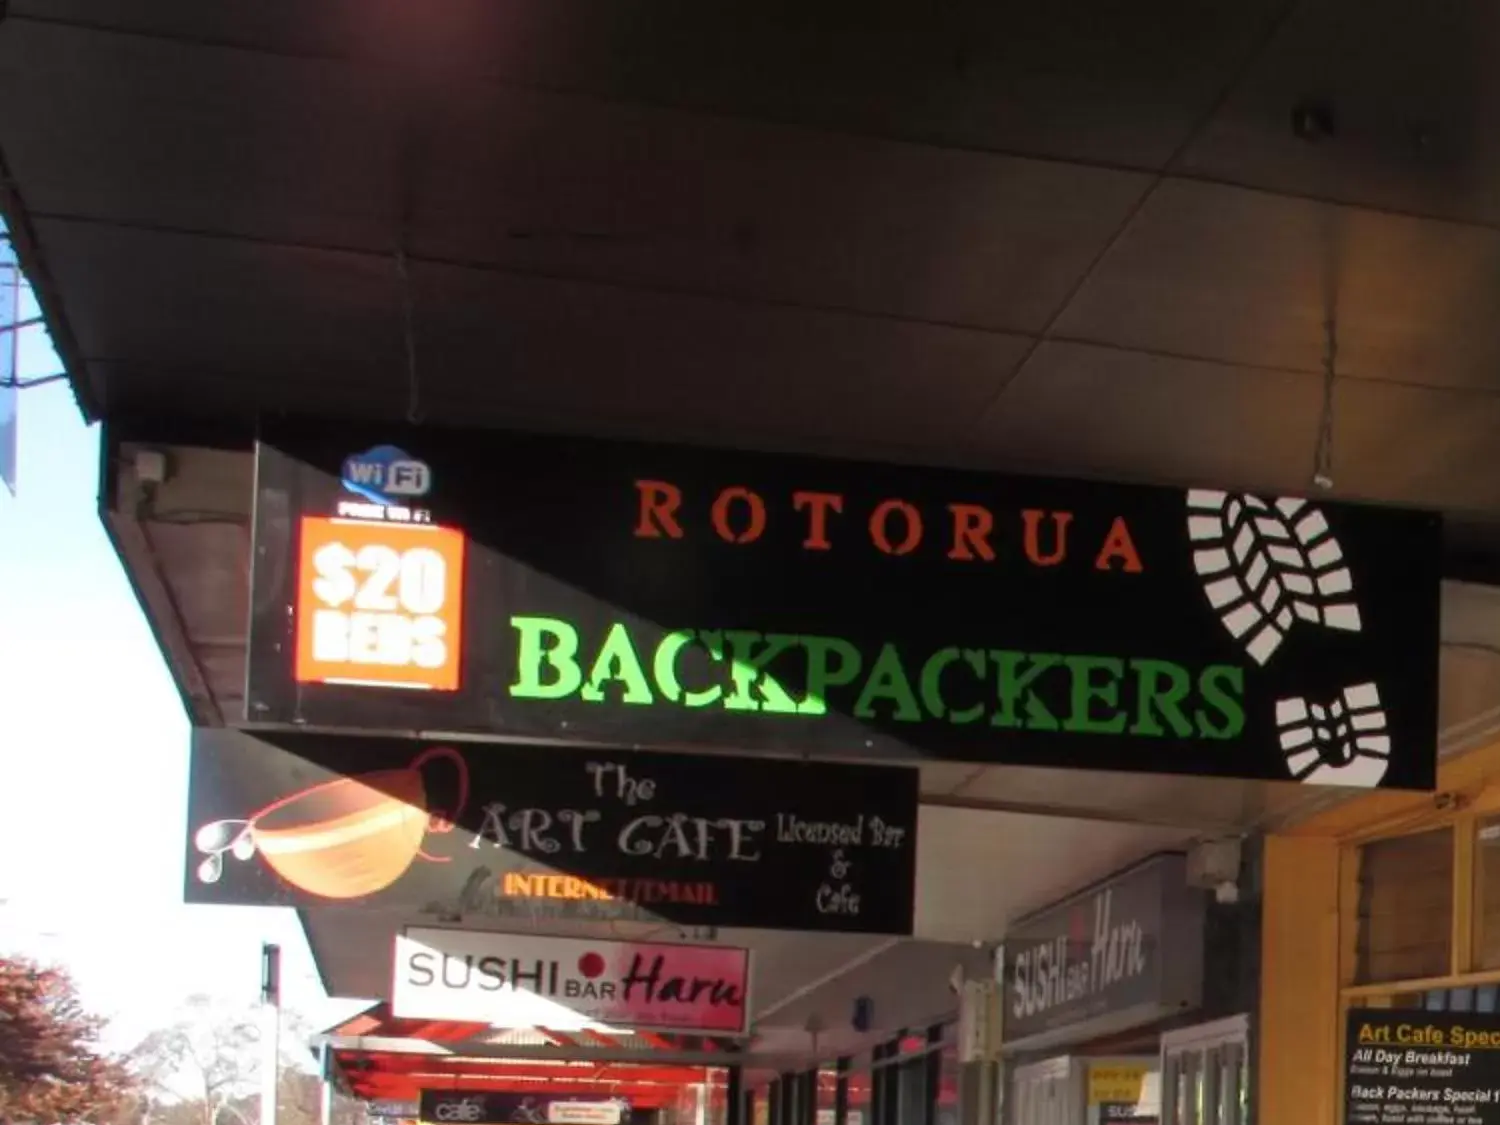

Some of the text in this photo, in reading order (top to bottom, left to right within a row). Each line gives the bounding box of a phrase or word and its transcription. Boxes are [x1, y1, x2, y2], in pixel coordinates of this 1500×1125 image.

[634, 478, 1143, 573] ROTORUA
[312, 541, 446, 613] $20
[312, 609, 447, 668] BEDS
[508, 614, 1246, 740] BACKPACKERS
[586, 759, 657, 807] The
[468, 803, 765, 862] ART CAFE
[870, 815, 906, 848] Bar
[830, 849, 849, 878] &
[816, 883, 861, 915] Cafe
[407, 950, 744, 1007] SUSHI BAR Haru
[1012, 934, 1068, 1020] SUSHI
[1353, 1049, 1373, 1063] All
[1375, 1050, 1401, 1067] Day
[1405, 1051, 1471, 1066] Breakfast
[1358, 1023, 1390, 1043] Art
[1396, 1024, 1444, 1045] Cafe
[1387, 1086, 1440, 1100] Packers
[1443, 1087, 1491, 1105] Special
[1493, 1090, 1500, 1103] 1
